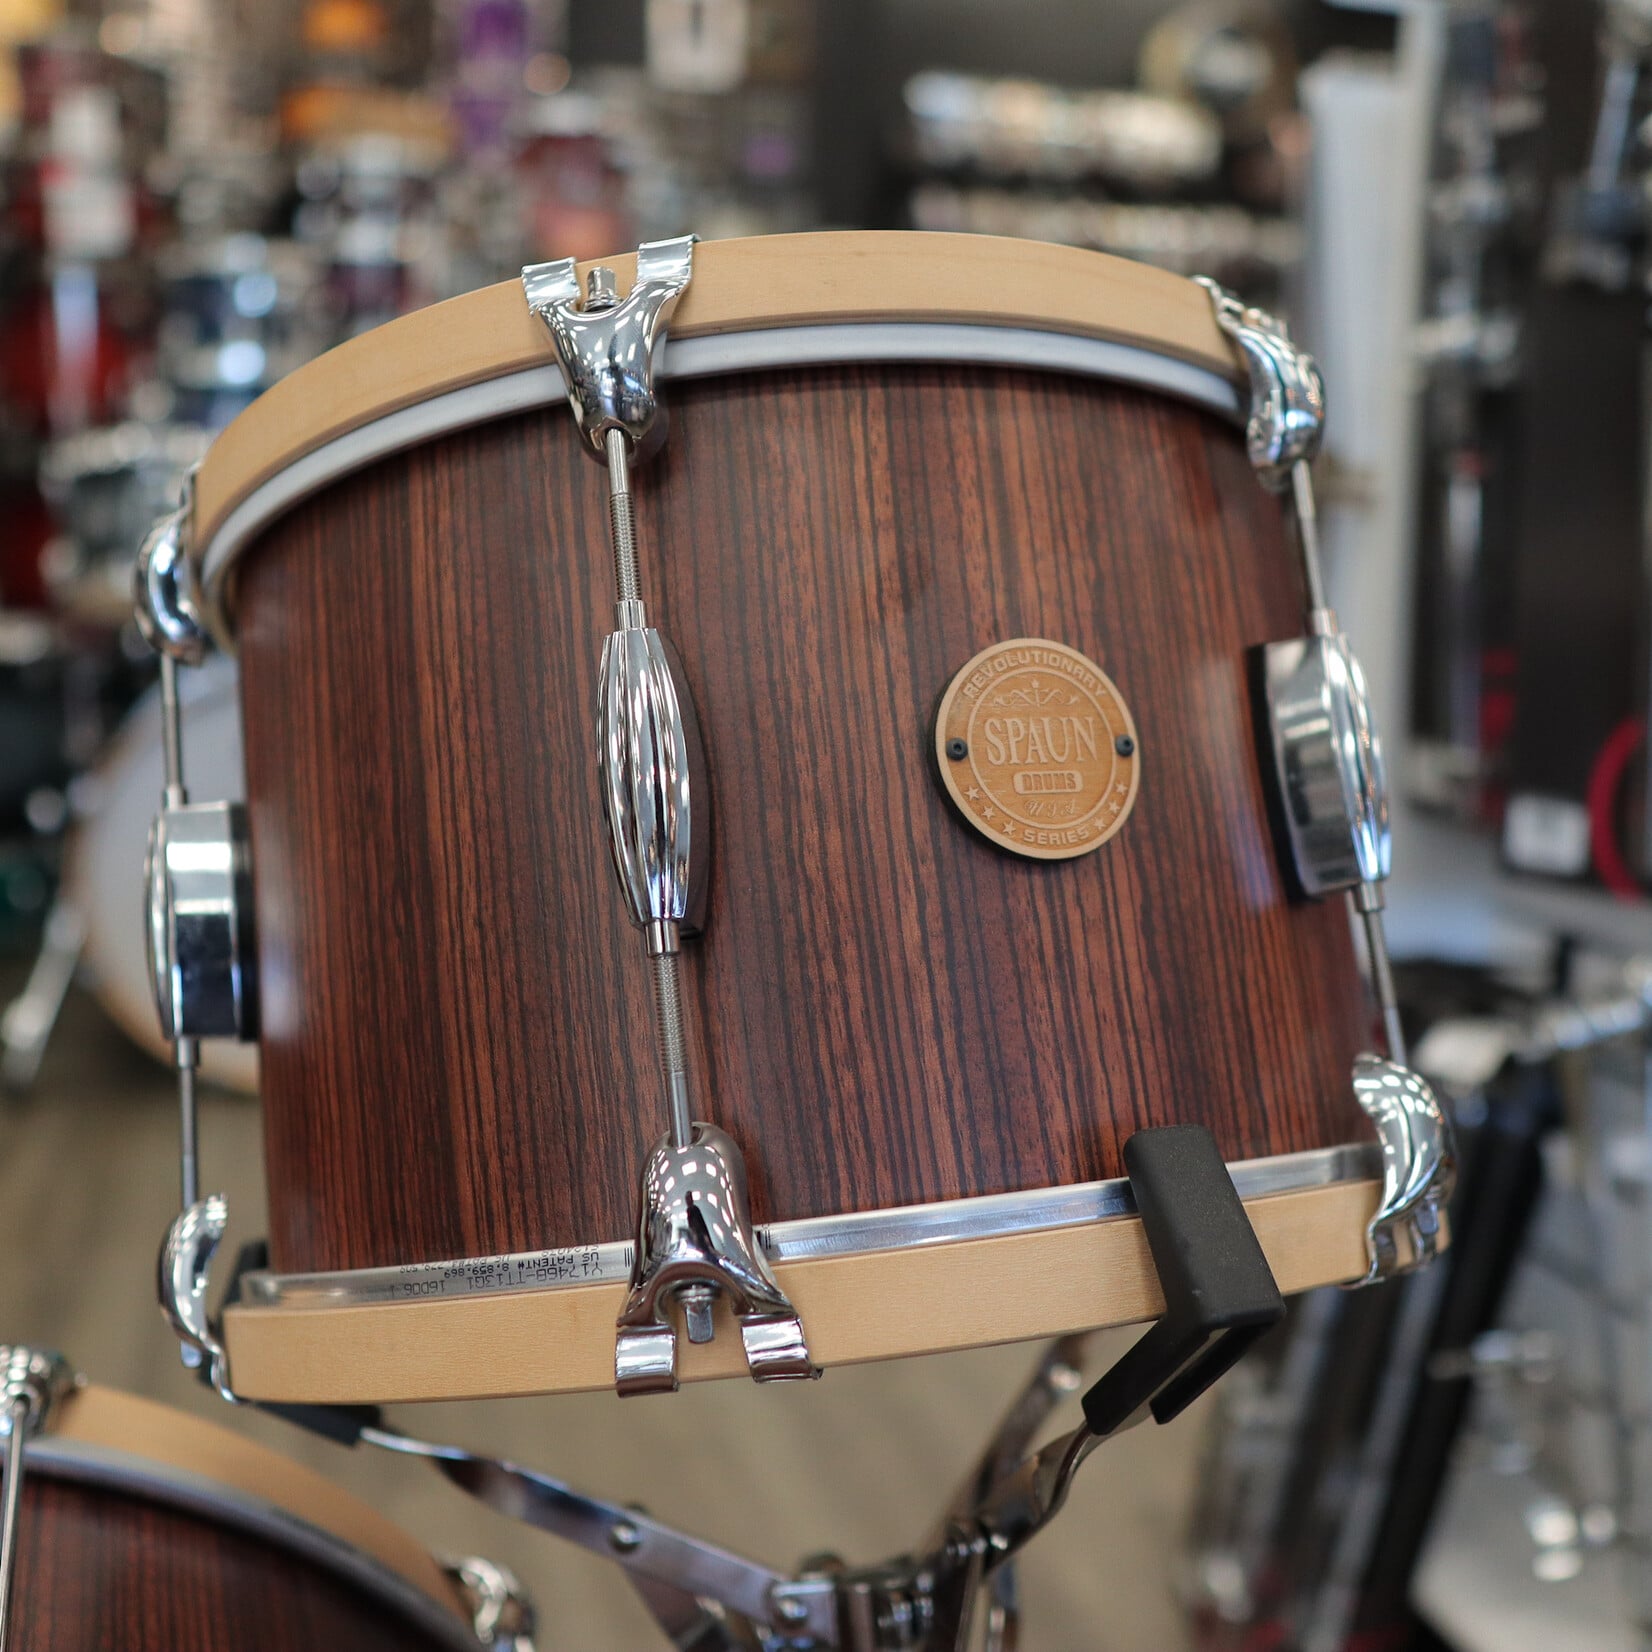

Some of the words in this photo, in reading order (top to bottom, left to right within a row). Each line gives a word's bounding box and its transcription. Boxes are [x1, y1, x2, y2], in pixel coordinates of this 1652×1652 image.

[963, 651, 1107, 699] REVOLUTIONARY
[984, 716, 1098, 766] SPAUN
[1021, 772, 1077, 792] DRUMS
[1023, 825, 1090, 845] SERIES
[517, 1255, 574, 1271] PATENT#
[582, 1252, 599, 1262] US
